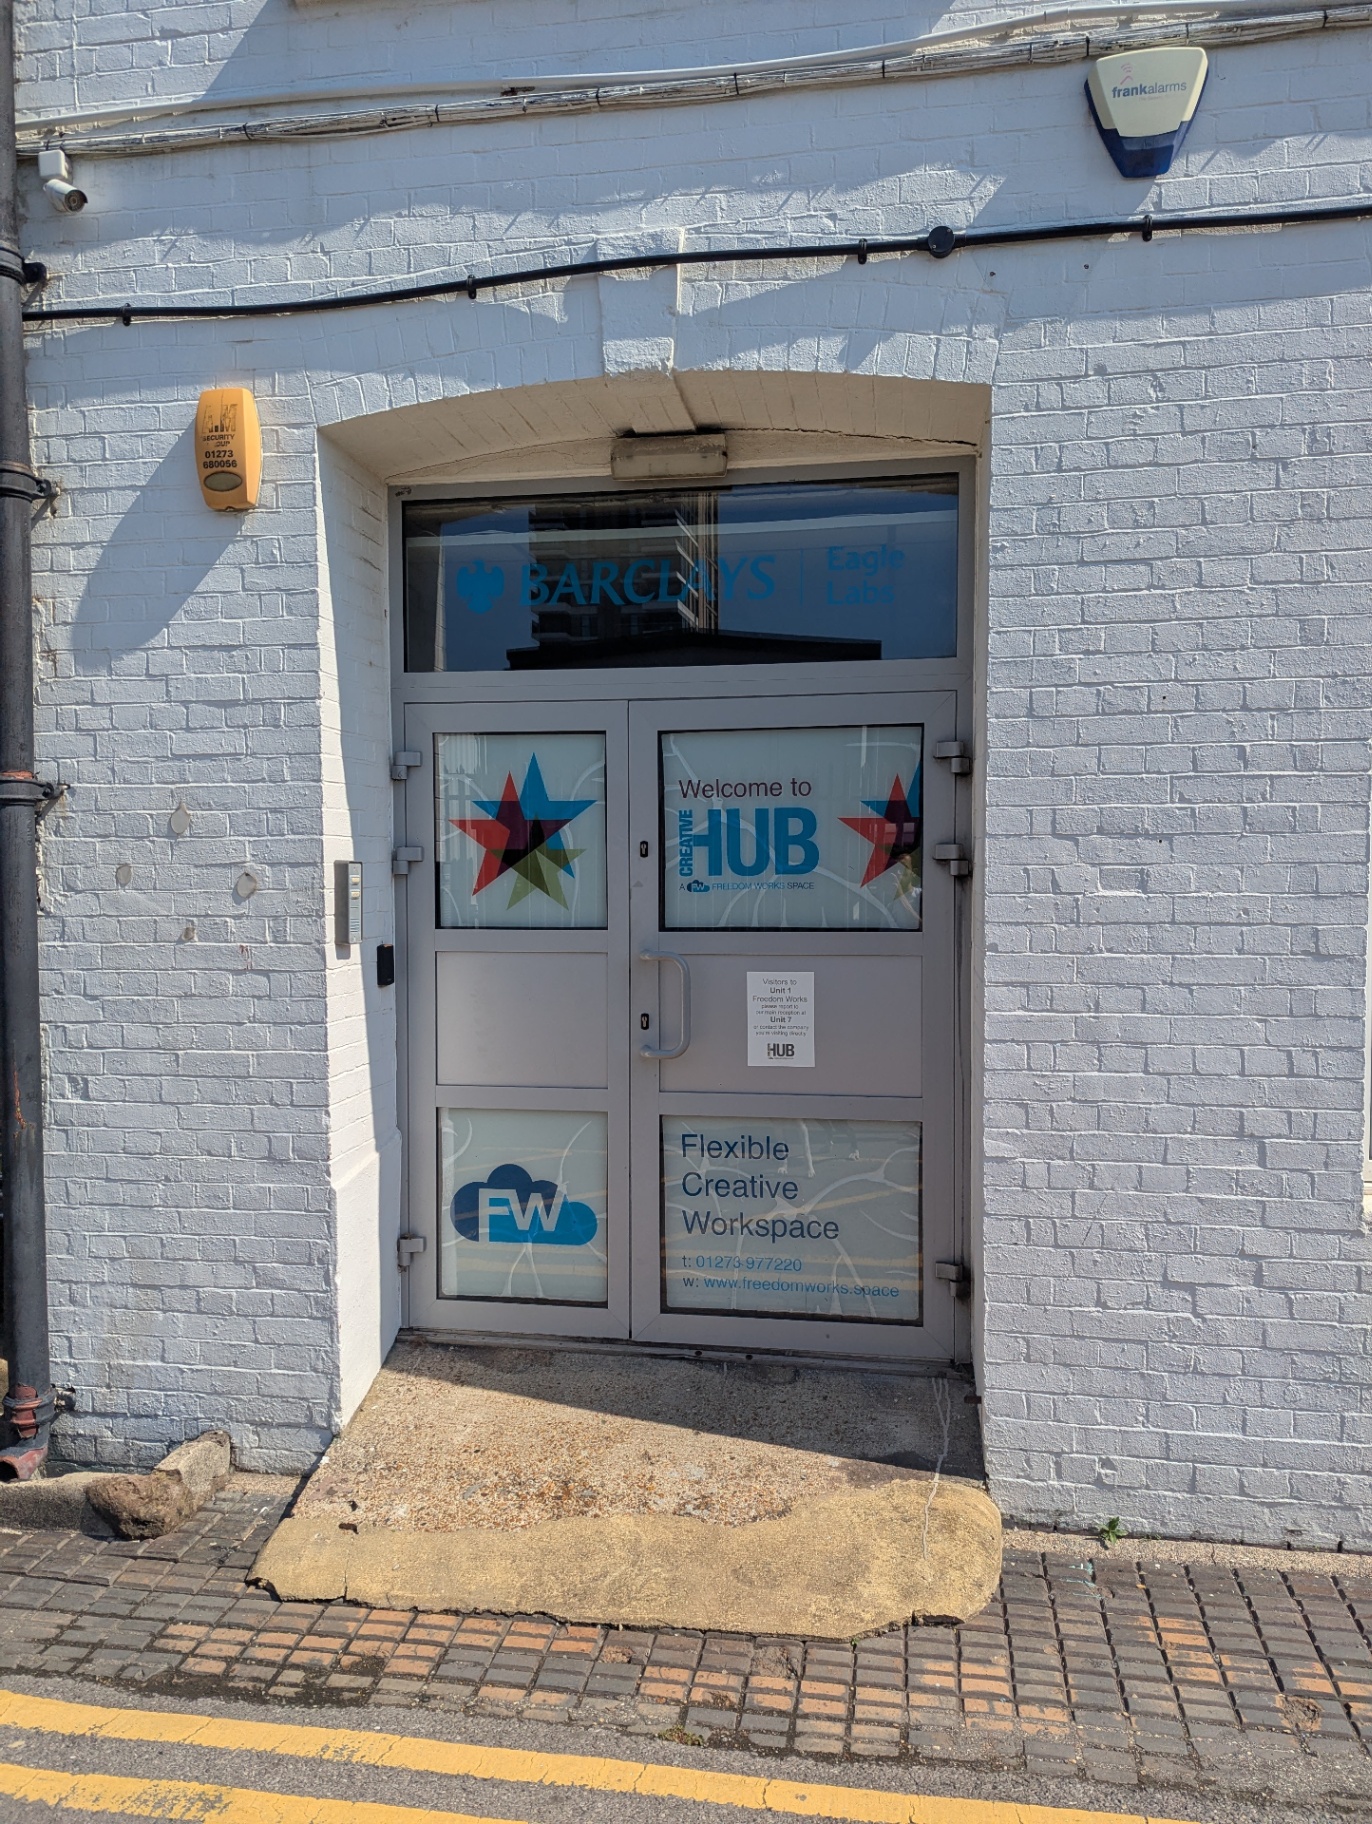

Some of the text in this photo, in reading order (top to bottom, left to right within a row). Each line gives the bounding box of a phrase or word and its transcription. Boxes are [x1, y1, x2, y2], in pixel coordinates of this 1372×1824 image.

[1111, 82, 1187, 98] frankalarms
[203, 460, 237, 469] 680056
[205, 450, 234, 459] 01273
[826, 544, 906, 576] Eagle
[519, 555, 776, 606] BARCLAYS
[826, 580, 894, 606] Labs
[678, 778, 812, 798] Welcome to
[678, 809, 693, 877] CREATIVE
[692, 807, 820, 877] HUB
[712, 882, 752, 891] FREEDOM
[754, 881, 785, 890] WORKS
[786, 881, 815, 889] SPACE
[752, 995, 808, 1003] Freedom Works
[767, 1043, 795, 1057] HUB
[681, 1134, 789, 1160] Flexible
[682, 1171, 799, 1200] Creative
[478, 1188, 567, 1243] FW
[682, 1210, 839, 1244] Workspace
[695, 1255, 742, 1270] 01273
[745, 1256, 802, 1272] 977220
[703, 1276, 900, 1298] www.freedomworks.space
